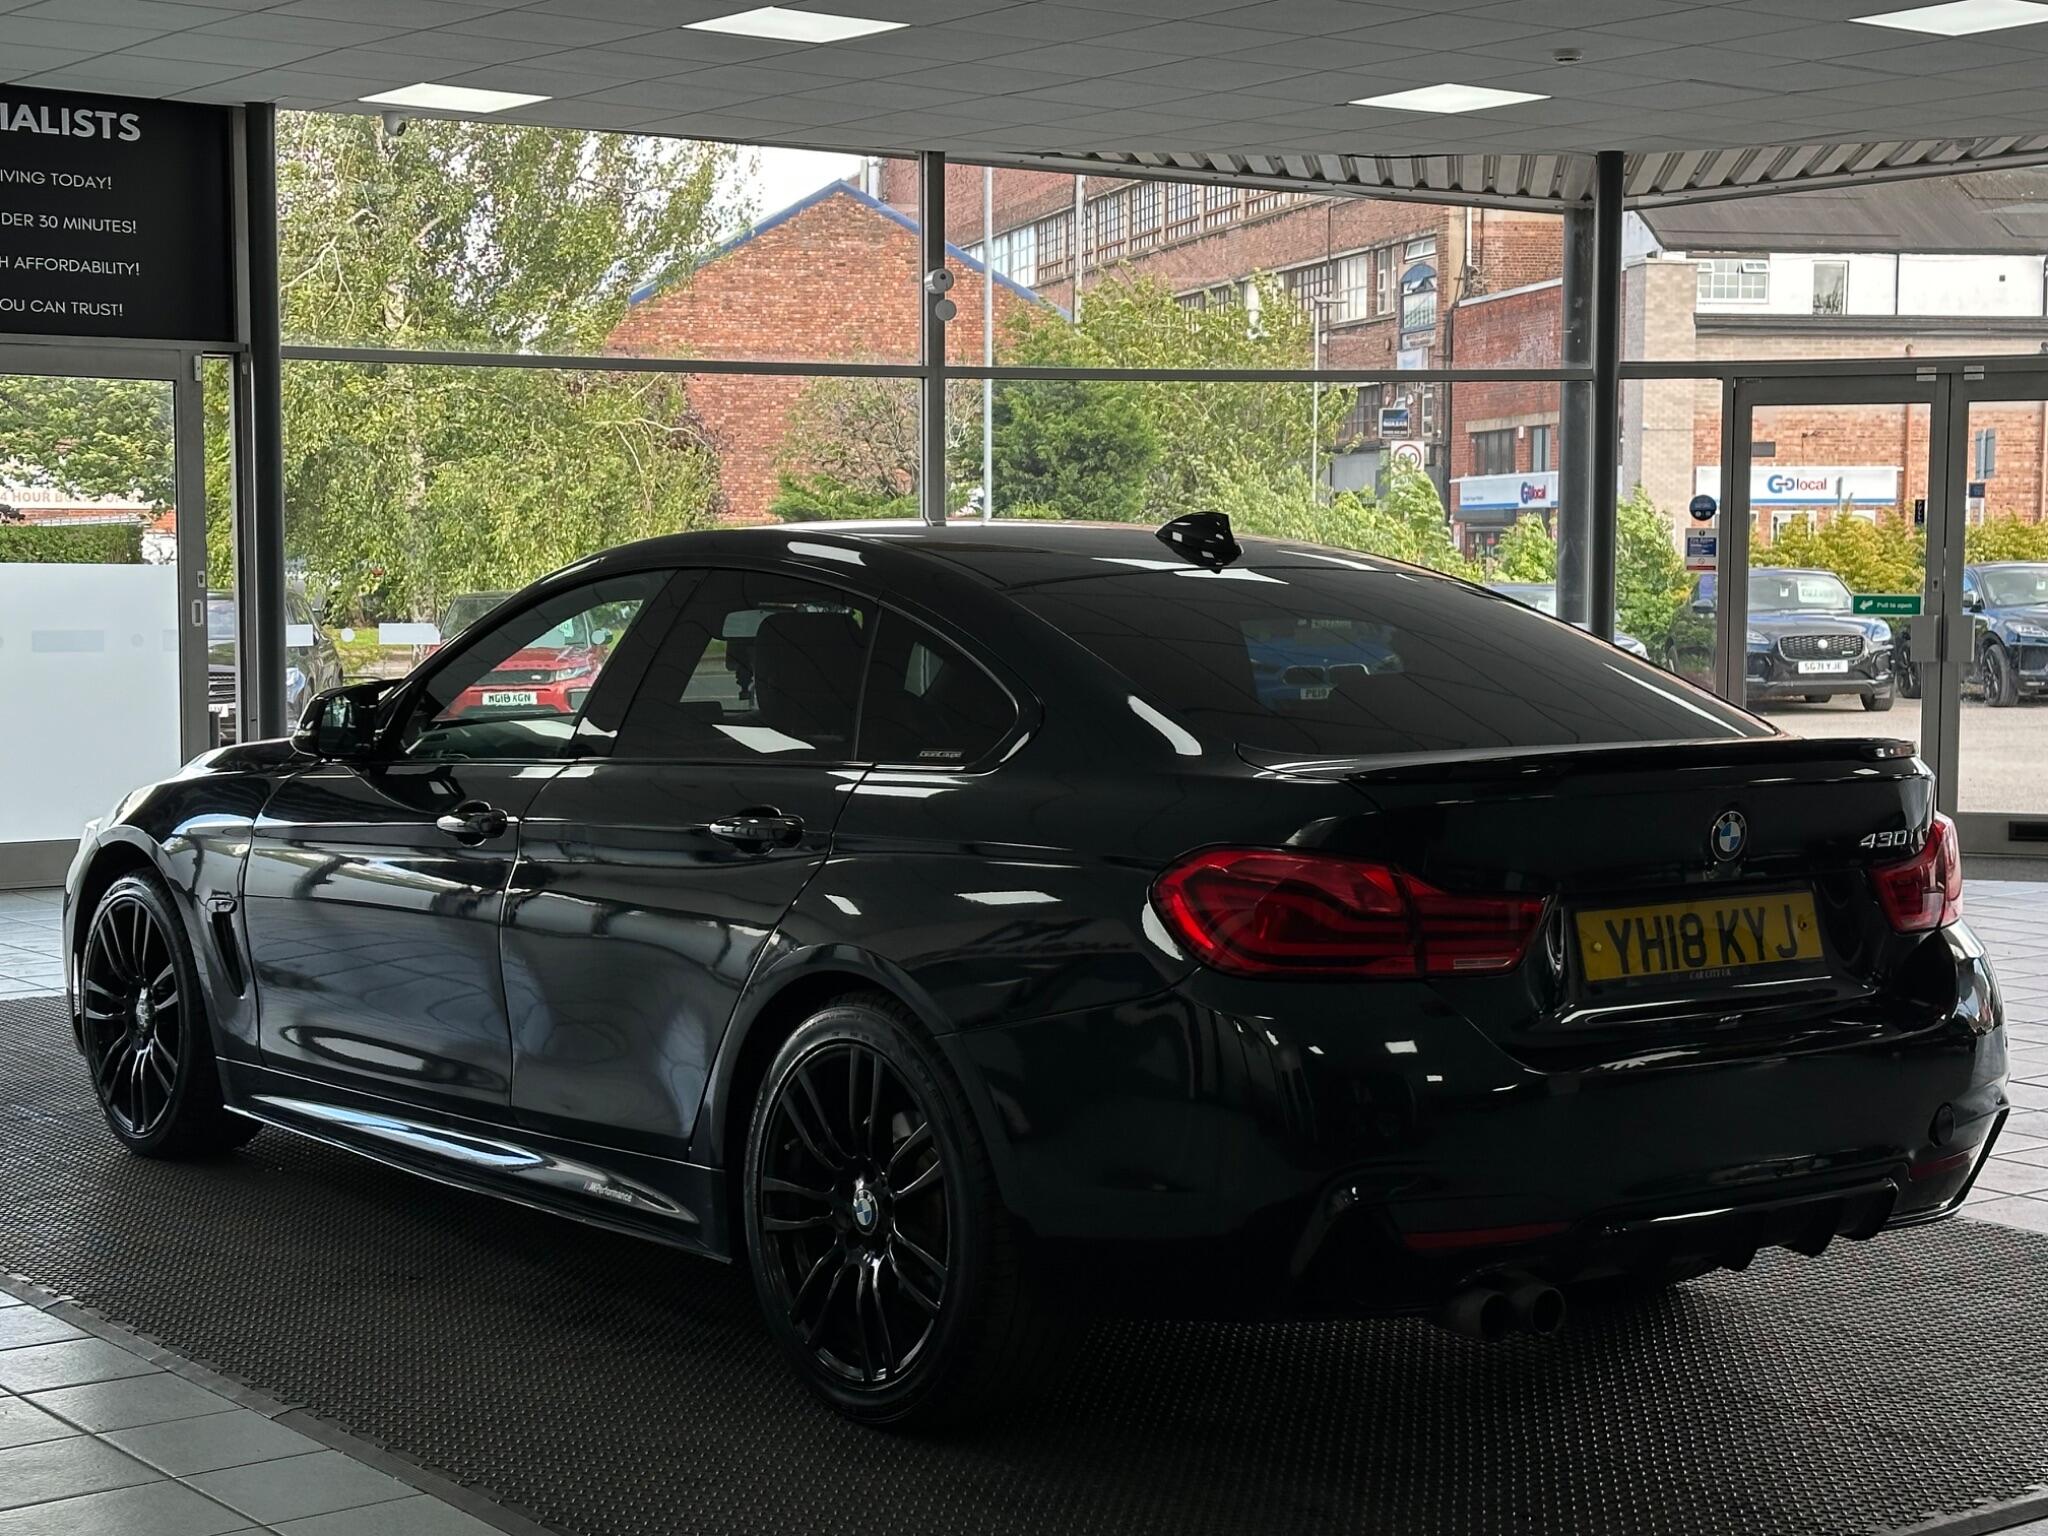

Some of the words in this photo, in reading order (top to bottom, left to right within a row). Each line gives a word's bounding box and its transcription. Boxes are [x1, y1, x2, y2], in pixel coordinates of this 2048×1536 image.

[0, 102, 141, 142] IALISTS
[0, 169, 46, 186] IVING
[51, 172, 112, 190] TODAY!
[1, 212, 34, 227] DER
[39, 215, 58, 229] 30
[63, 216, 137, 234] MINUTES!
[0, 255, 9, 268] H
[14, 256, 140, 276] AFFORDABILITY!
[0, 298, 25, 312] OU
[30, 300, 66, 313] CAN
[71, 301, 123, 317] TRUST!
[12, 491, 50, 503] HOUR
[1605, 911, 1708, 975] YH18
[1716, 904, 1798, 965] KYJ
